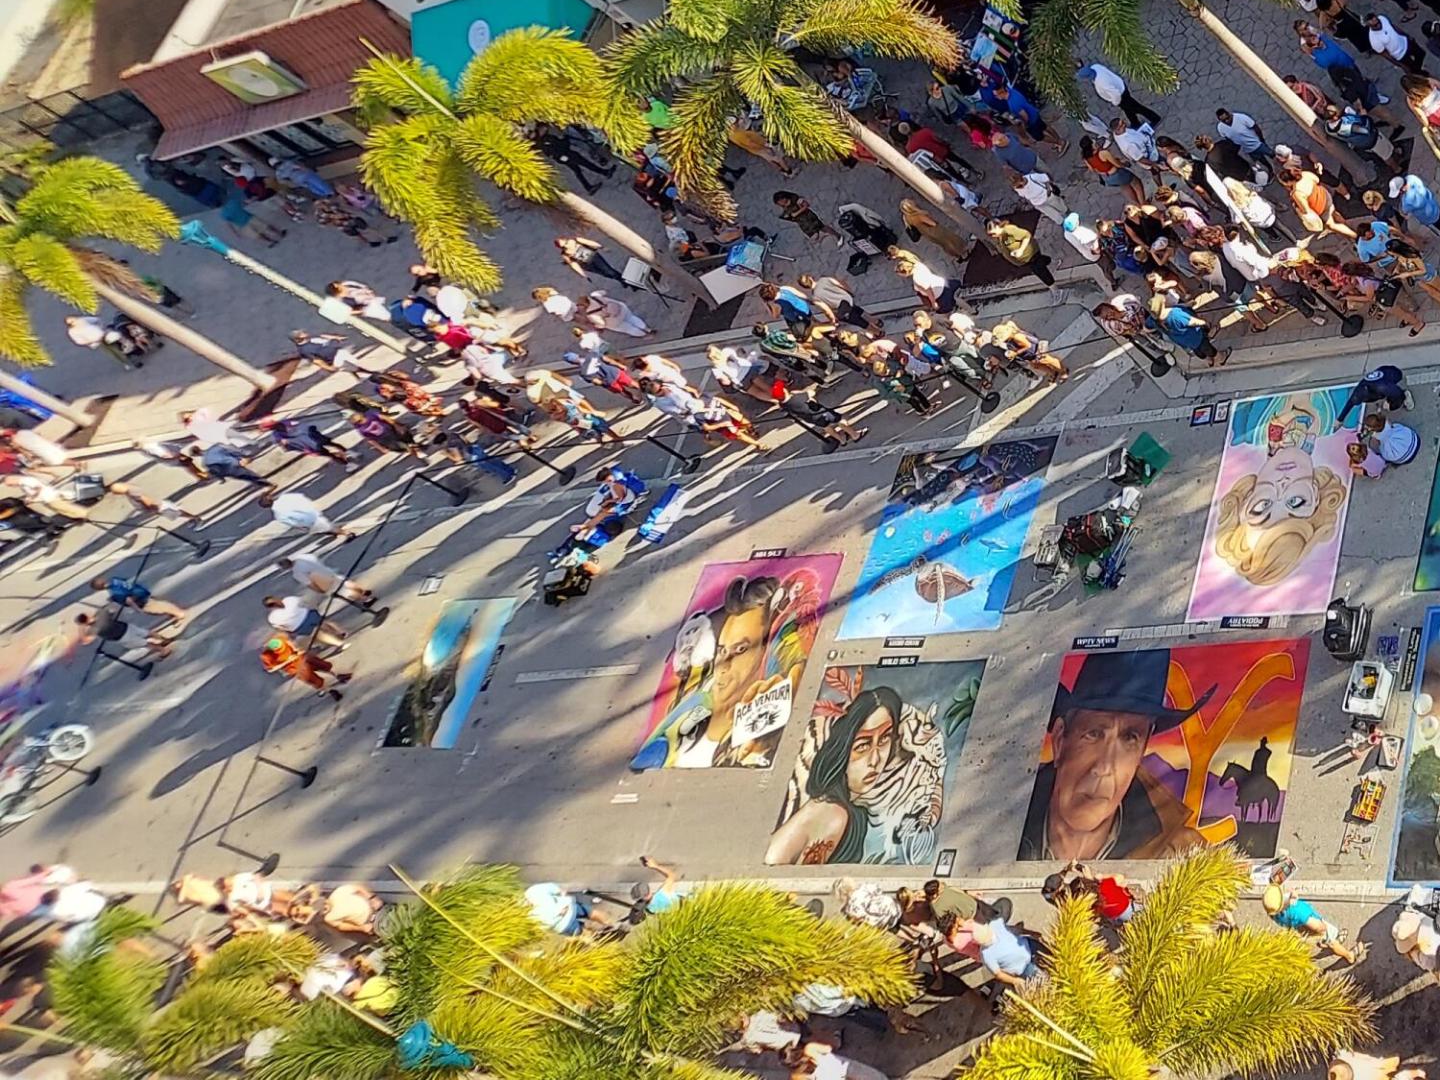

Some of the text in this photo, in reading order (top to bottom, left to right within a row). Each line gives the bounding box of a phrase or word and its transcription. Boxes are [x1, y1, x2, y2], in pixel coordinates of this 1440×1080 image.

[1227, 617, 1264, 625] PODIATRY
[735, 702, 753, 727] ACE
[755, 683, 790, 708] VENTURA
